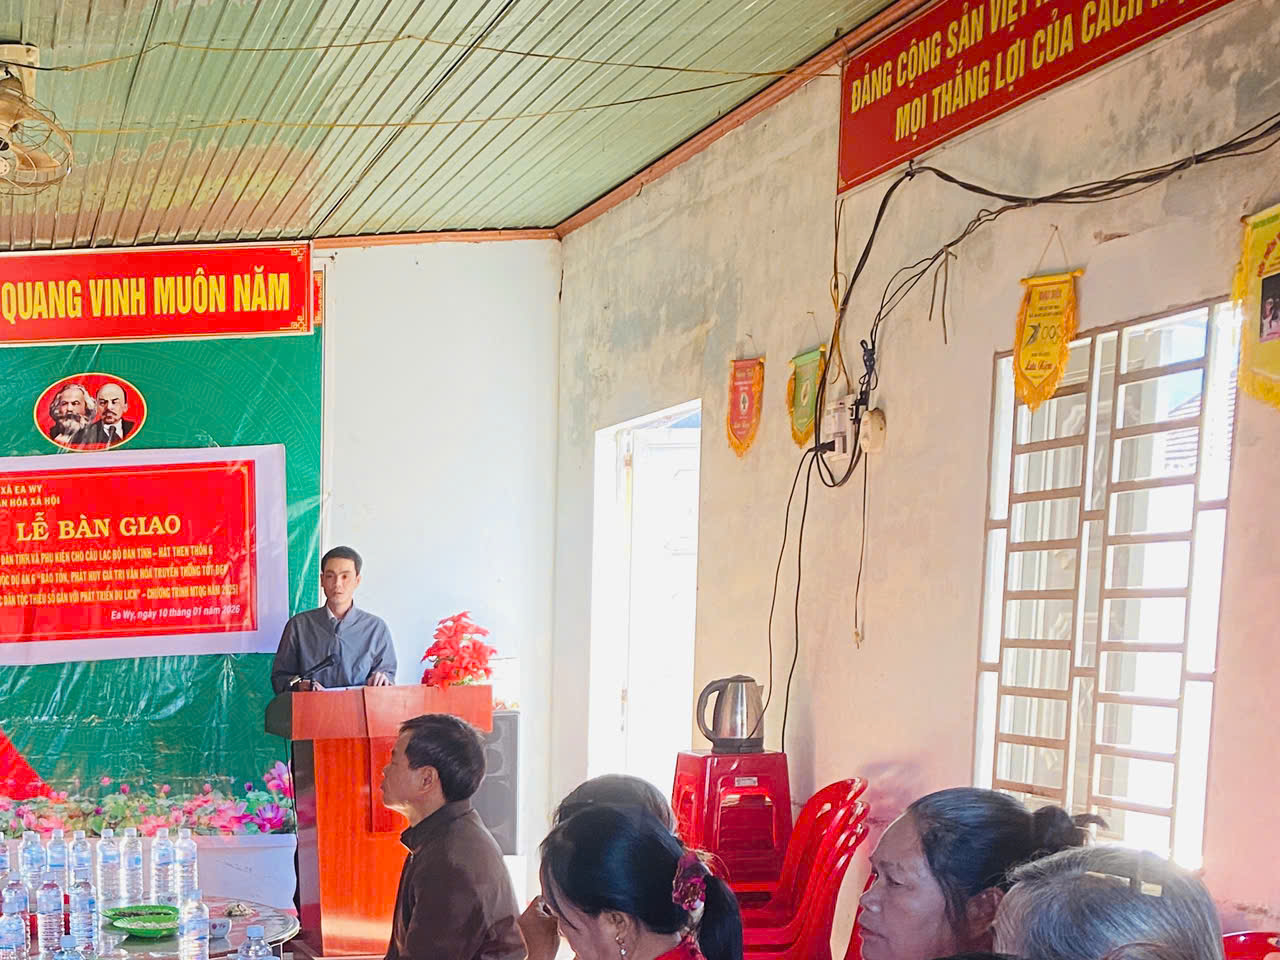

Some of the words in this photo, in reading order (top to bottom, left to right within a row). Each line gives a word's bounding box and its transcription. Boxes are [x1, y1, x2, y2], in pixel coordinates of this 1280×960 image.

[851, 62, 892, 114] ĐẢNG
[896, 39, 942, 89] CỘNG
[946, 2, 984, 59] SẢN
[896, 94, 927, 142] MỌI
[932, 60, 990, 123] THẮNG
[995, 38, 1026, 92] LỢI
[1032, 8, 1074, 70] CỦA
[0, 279, 82, 325] QUANG
[89, 277, 146, 317] VINH
[153, 267, 226, 314] MUÔN
[233, 265, 290, 312] NĂM
[0, 484, 13, 496] XÃ
[14, 485, 27, 495] EA
[28, 484, 43, 495] WY
[10, 496, 29, 507] HÓA
[30, 494, 42, 506] XÃ
[44, 494, 60, 507] HỘI
[16, 512, 49, 542] LỄ
[58, 513, 111, 540] BÀN
[119, 515, 182, 537] GIAO
[31, 550, 40, 564] VÀ
[41, 552, 53, 565] PHỤ
[55, 549, 70, 564] KIỆN
[71, 550, 84, 562] CHO
[172, 545, 190, 557] THEN
[70, 570, 87, 582] PHÁT
[88, 570, 101, 582] HUY
[102, 568, 113, 581] GIÁ
[111, 610, 121, 620] Ea
[123, 609, 136, 620] Wy,
[137, 608, 157, 621] ngày
[159, 608, 168, 618] 10
[169, 606, 192, 618] tháng
[193, 606, 202, 616] 01
[203, 605, 221, 615] năm
[222, 604, 240, 614] 2026
